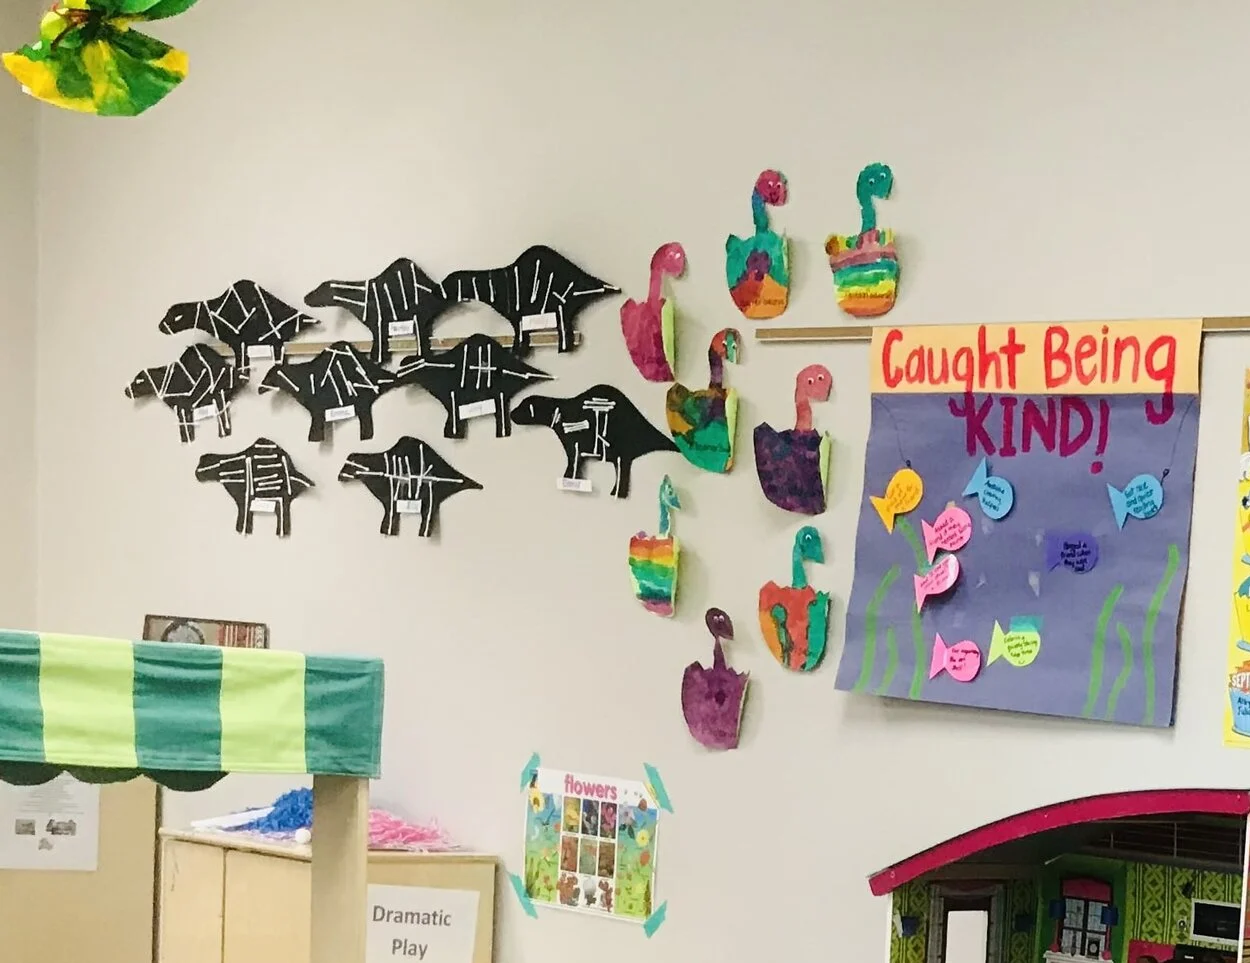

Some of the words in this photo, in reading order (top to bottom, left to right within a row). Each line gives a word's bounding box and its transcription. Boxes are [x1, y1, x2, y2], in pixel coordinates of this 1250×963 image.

[882, 324, 1026, 417] Caught
[1044, 325, 1176, 425] Being
[964, 394, 1110, 474] KIND!
[564, 773, 618, 801] flowers
[372, 905, 452, 927] Dramatic
[391, 938, 428, 961] Play
